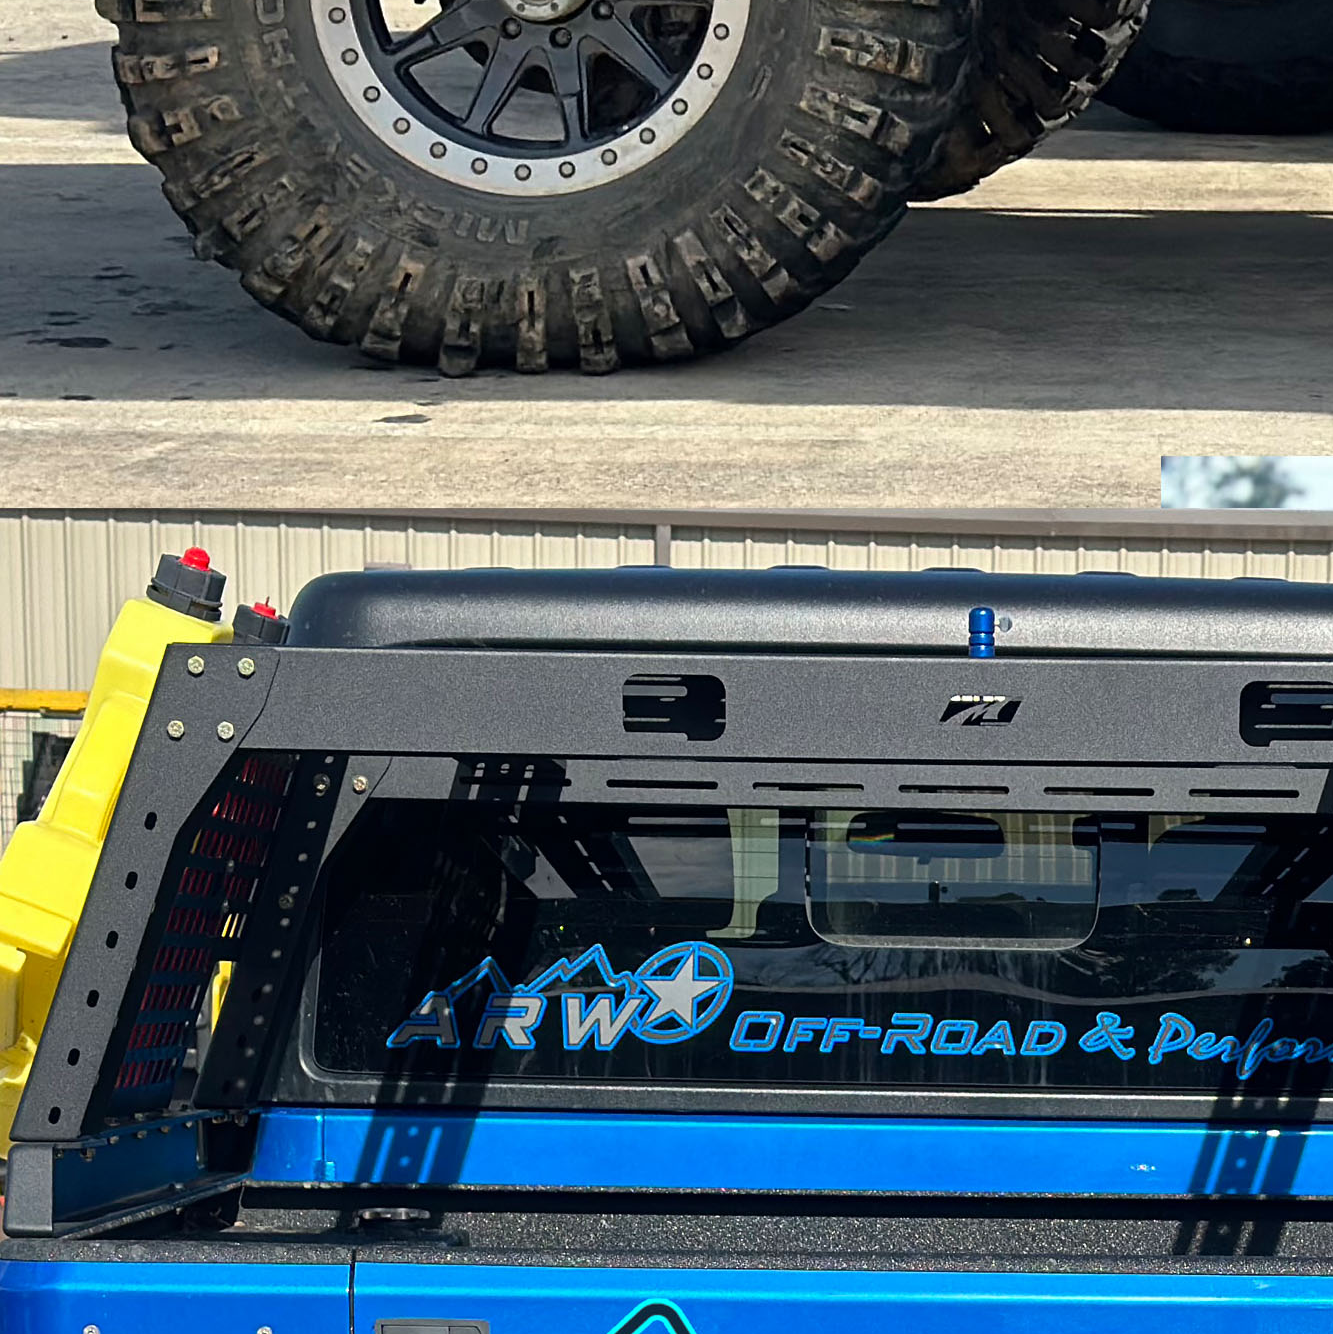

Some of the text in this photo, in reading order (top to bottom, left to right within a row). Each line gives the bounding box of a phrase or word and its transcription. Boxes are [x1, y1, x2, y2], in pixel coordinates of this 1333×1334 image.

[385, 991, 650, 1051] ARW
[728, 1011, 1068, 1057] OFF-ROAD
[1078, 1011, 1136, 1062] &
